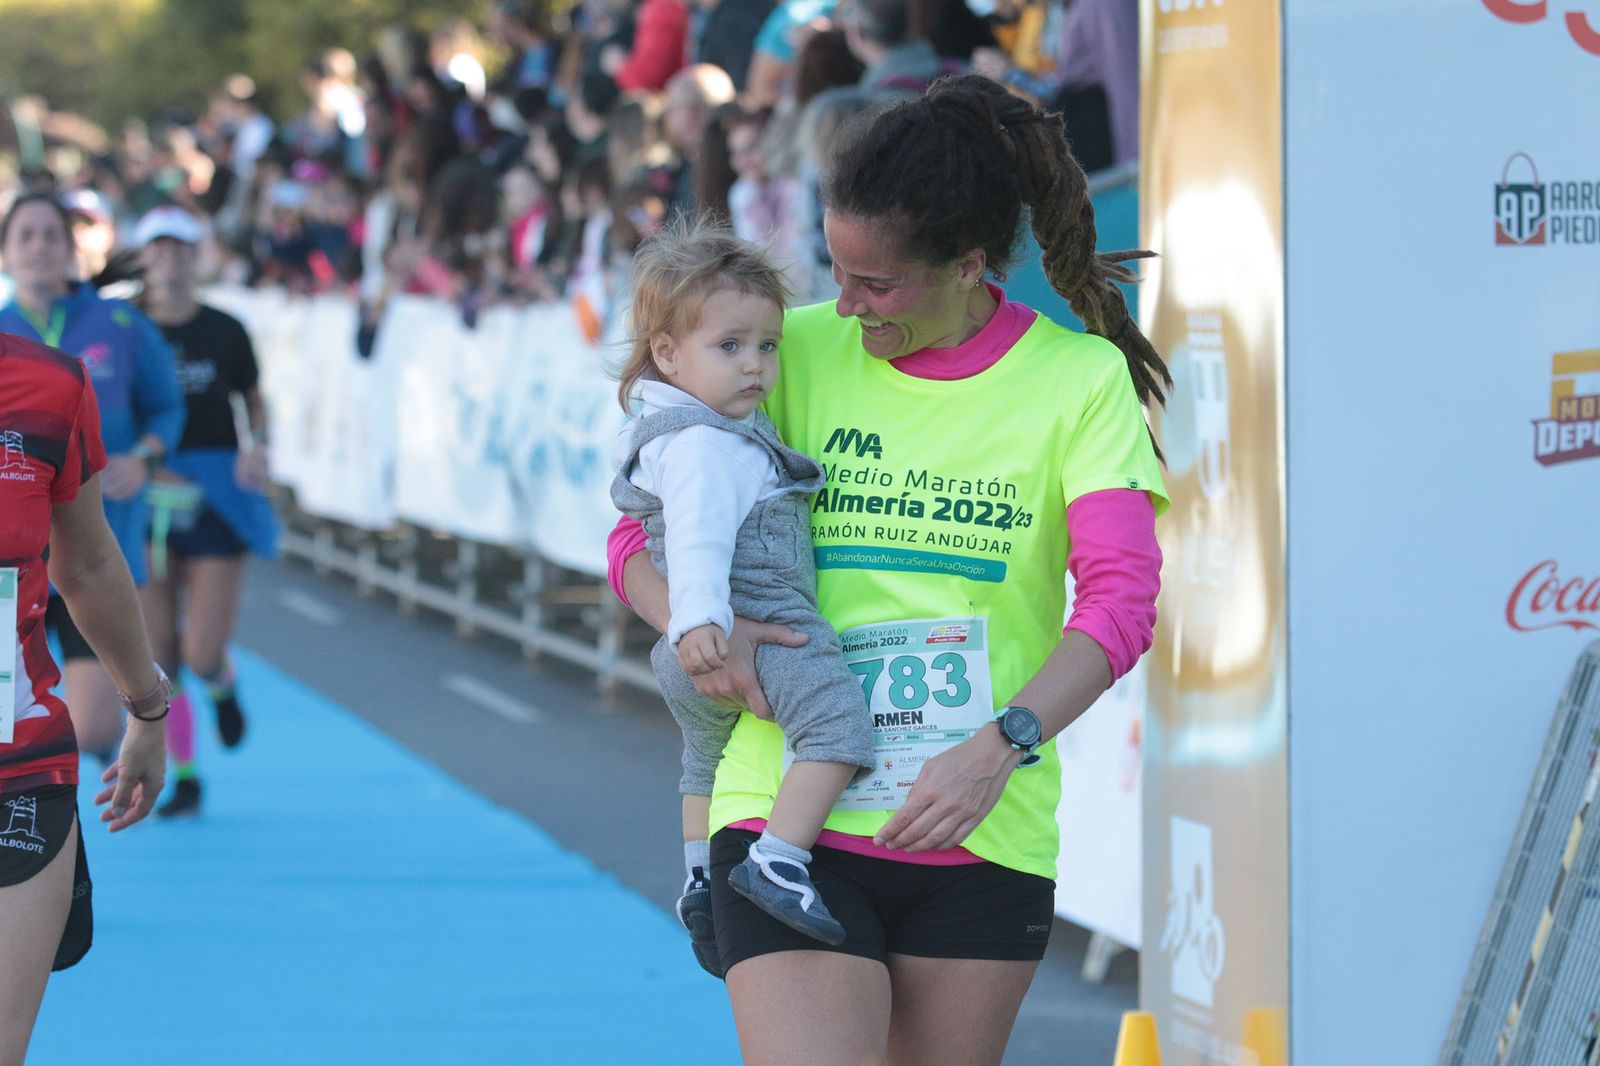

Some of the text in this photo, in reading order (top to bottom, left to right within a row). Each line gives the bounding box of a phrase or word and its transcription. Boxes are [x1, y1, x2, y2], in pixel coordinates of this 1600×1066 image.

[1551, 214, 1600, 245] PIED
[1560, 397, 1600, 420] MO
[0, 472, 36, 481] ALBOLOTE
[822, 462, 893, 487] Medio
[904, 470, 1017, 499] Maratón
[812, 487, 925, 518] Almería
[811, 522, 1012, 554] RAMÓN RUIZ ANDÚJAR
[841, 633, 866, 644] Medio
[842, 638, 878, 654] Almería
[848, 652, 972, 711] 783
[873, 711, 923, 727] RMEN
